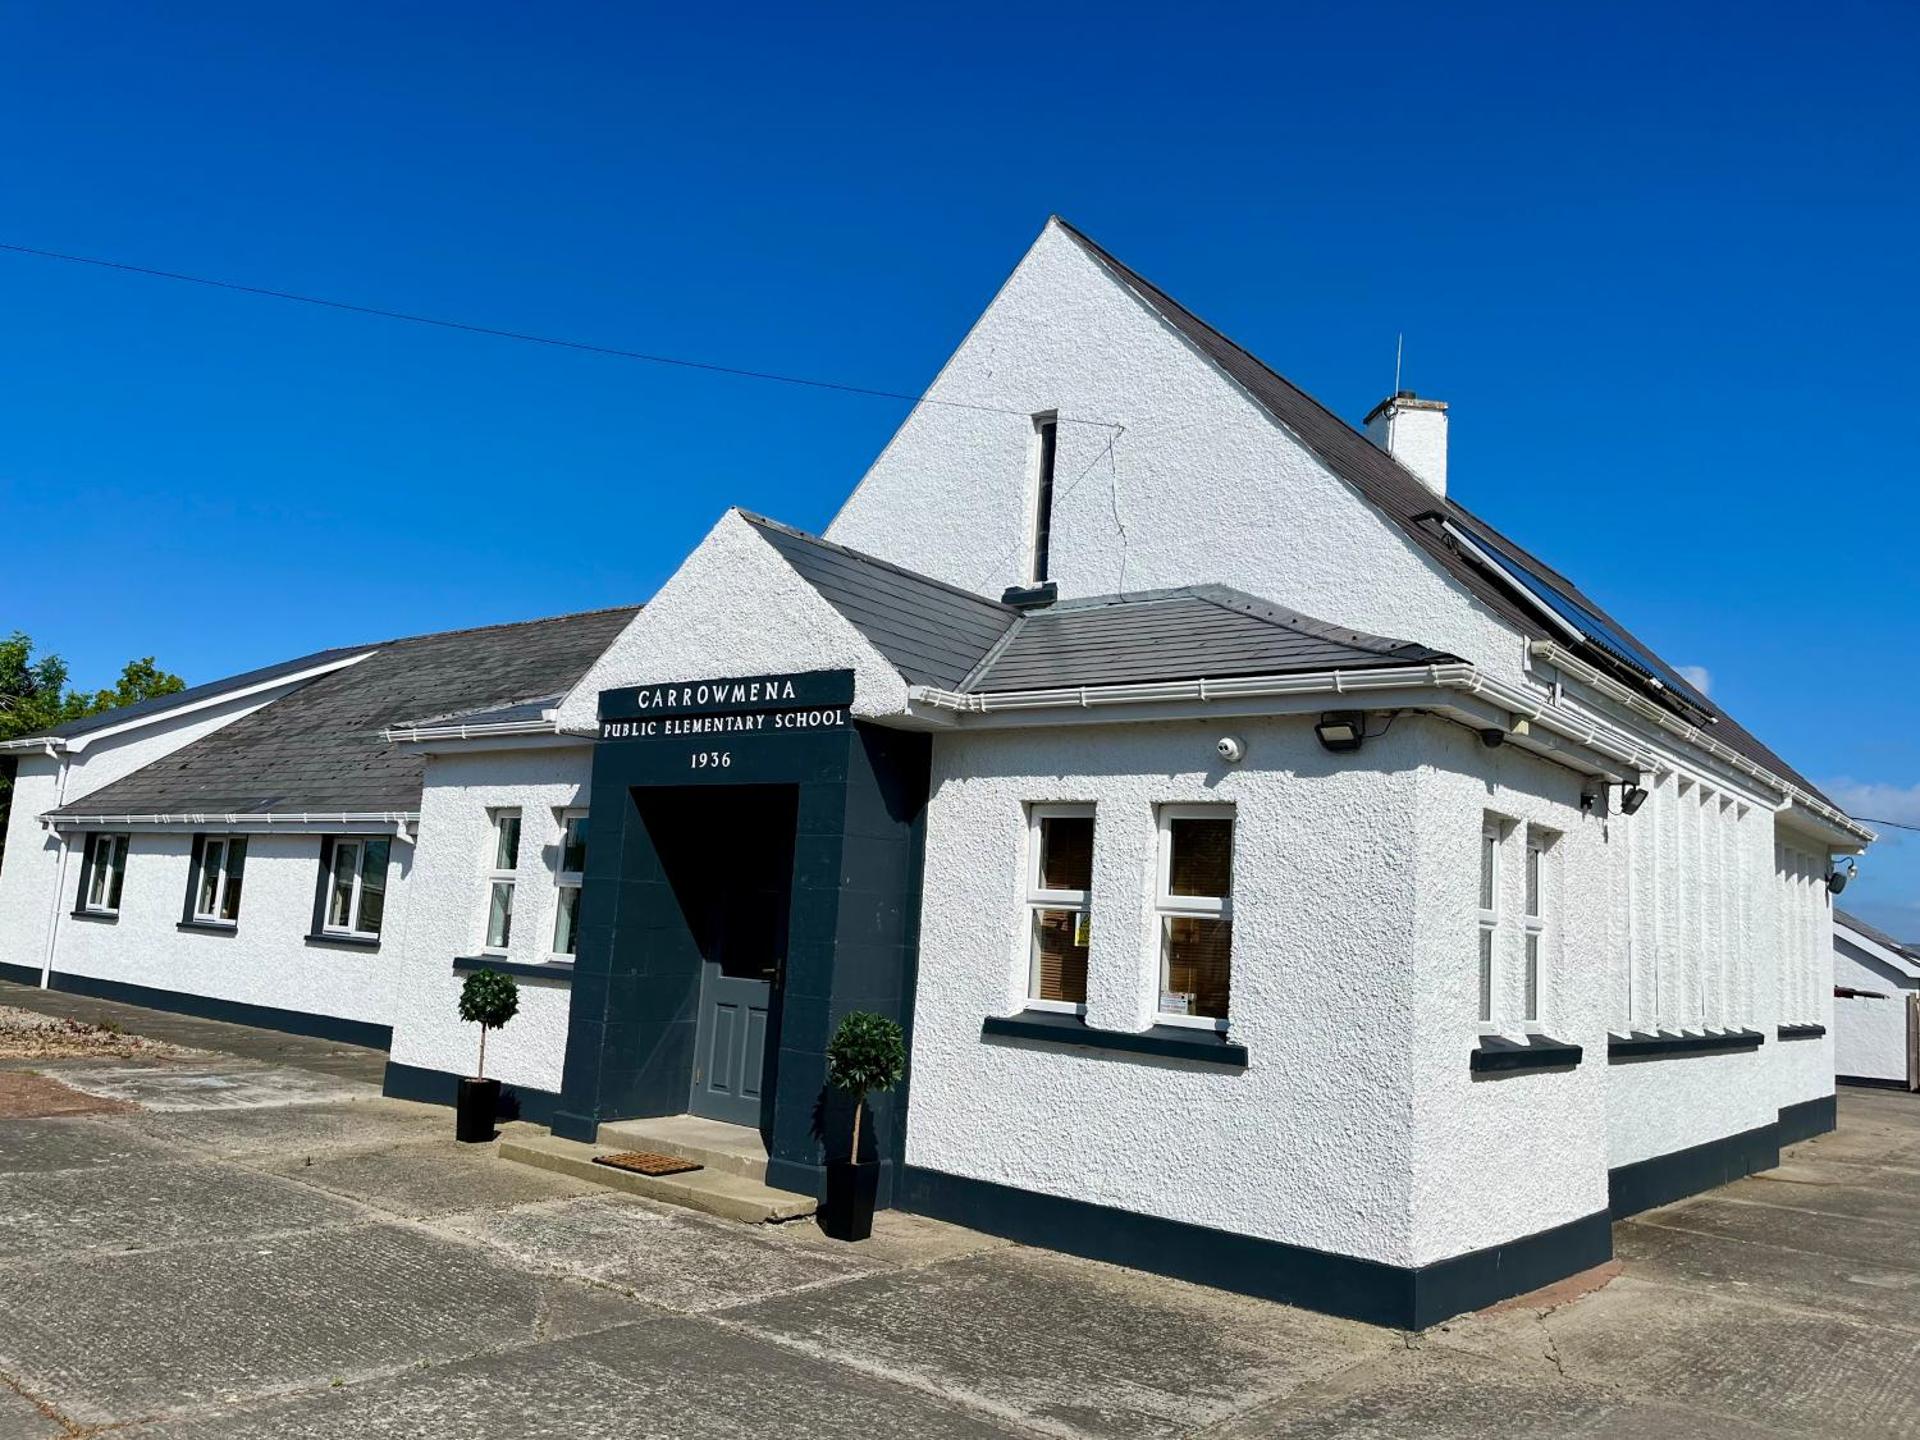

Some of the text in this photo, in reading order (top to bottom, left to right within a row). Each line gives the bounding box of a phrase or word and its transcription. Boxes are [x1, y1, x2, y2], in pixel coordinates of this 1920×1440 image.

[637, 681, 796, 709] CARROWMENA
[604, 710, 845, 737] PUBLIC ELEMENTARY SCHOOL
[691, 752, 731, 768] 1936
